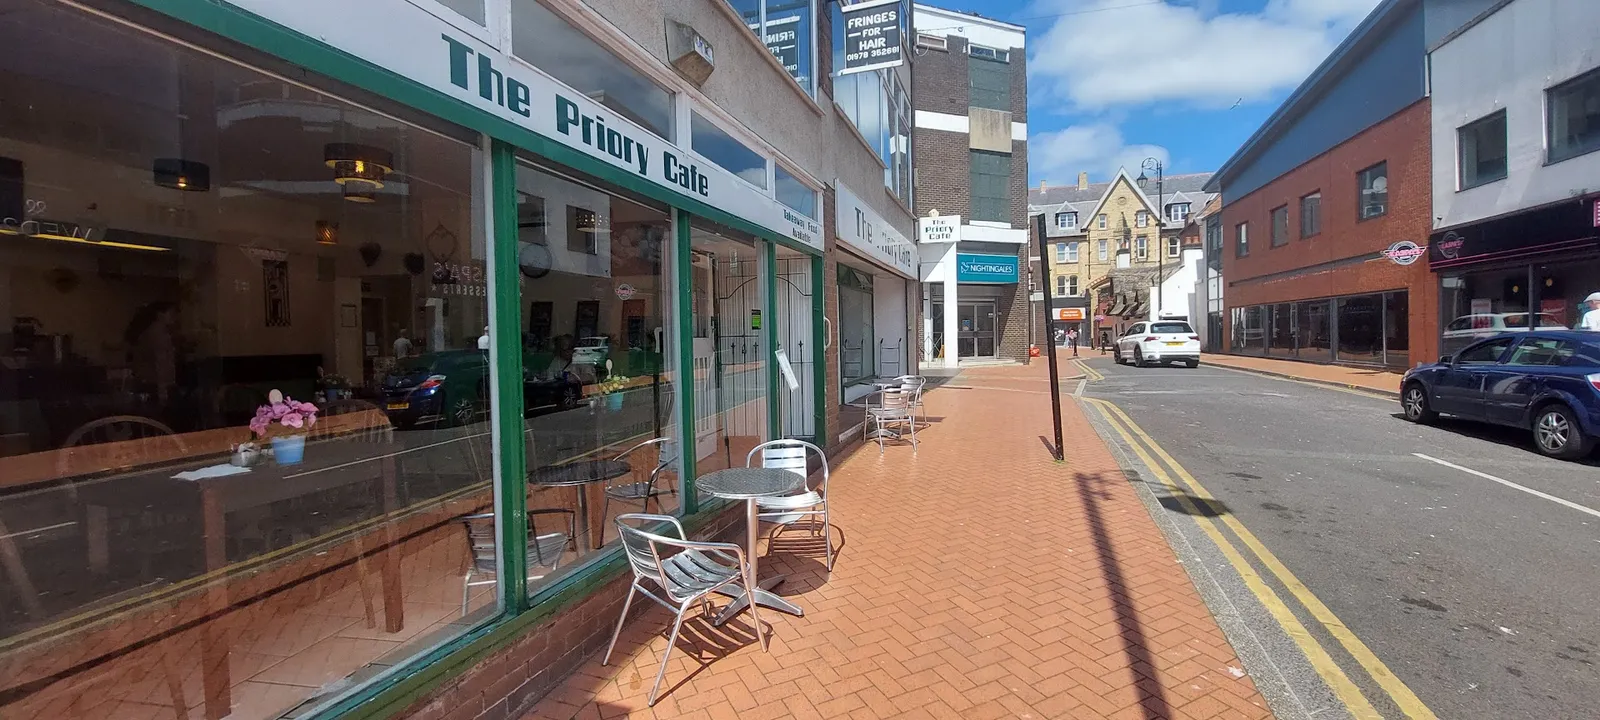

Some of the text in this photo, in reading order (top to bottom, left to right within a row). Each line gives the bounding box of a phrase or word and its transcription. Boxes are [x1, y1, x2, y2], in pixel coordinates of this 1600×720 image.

[848, 11, 896, 29] FRINGES
[863, 27, 881, 37] FOR
[859, 37, 886, 51] HAIR
[847, 51, 868, 61] 01978
[441, 33, 708, 197] The Priory Cafe
[783, 209, 818, 235] Takeaway Food
[854, 207, 873, 243] The
[792, 227, 811, 243] Available
[970, 264, 1013, 273] NIGHTINGALES
